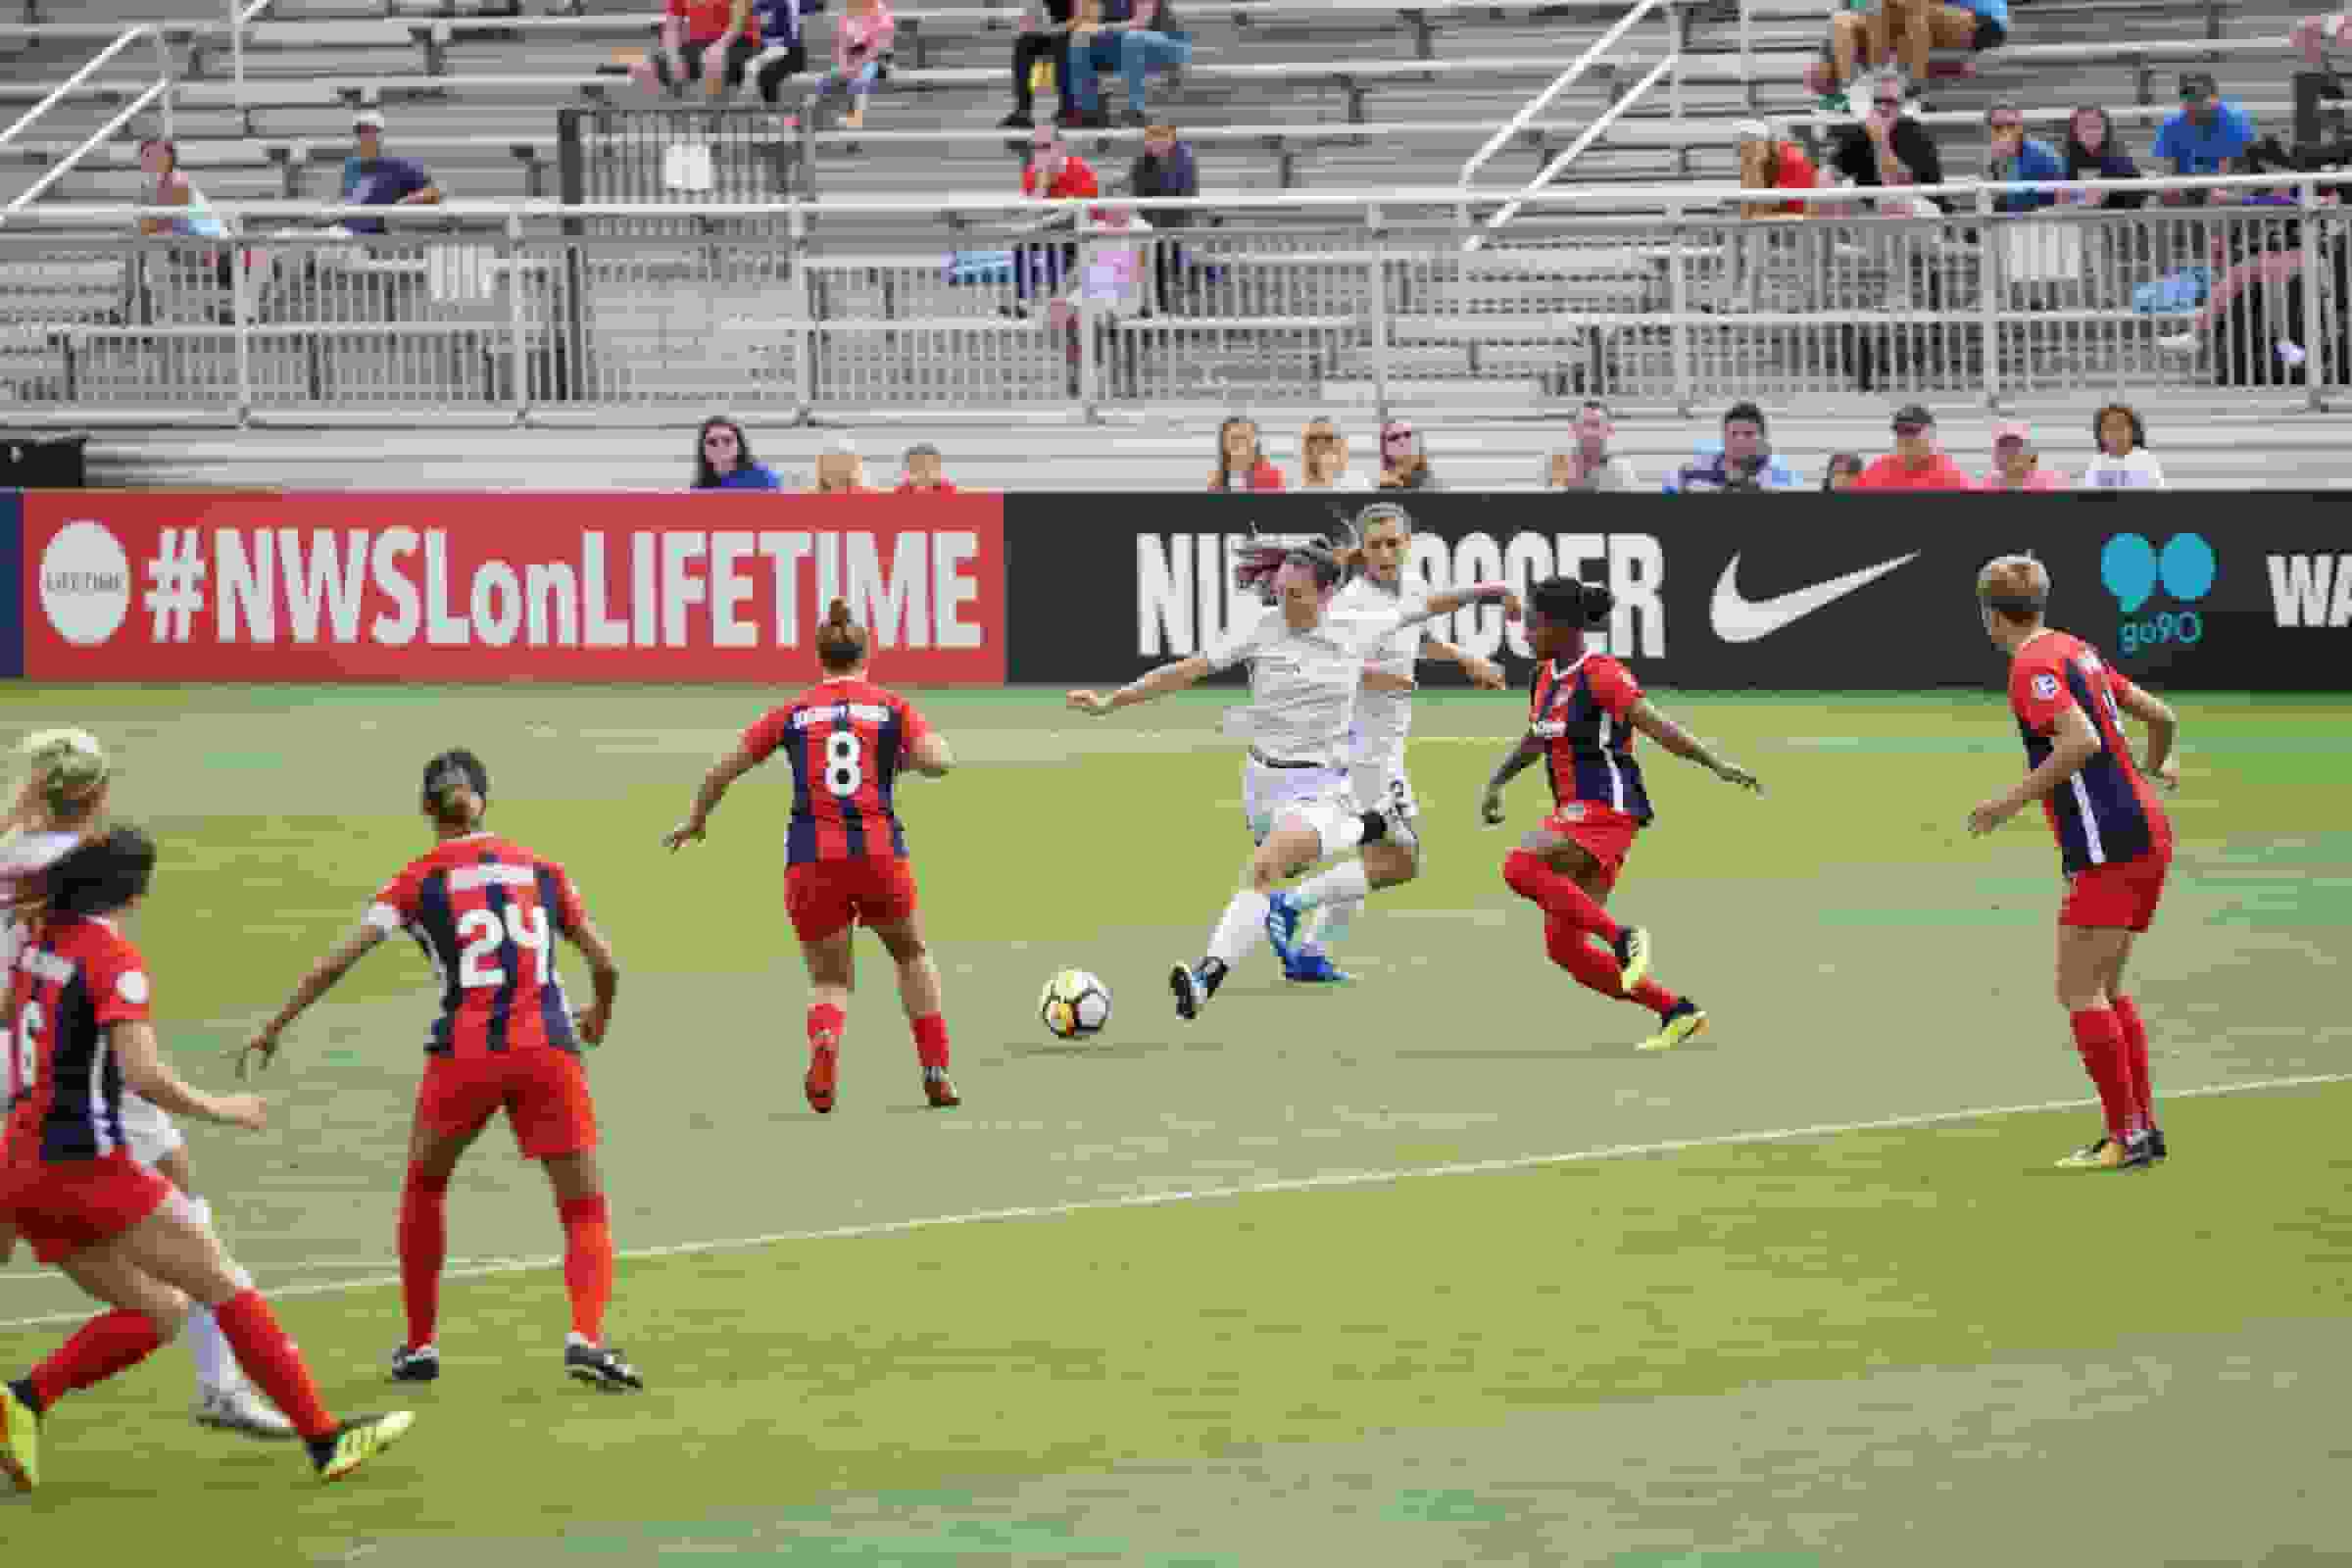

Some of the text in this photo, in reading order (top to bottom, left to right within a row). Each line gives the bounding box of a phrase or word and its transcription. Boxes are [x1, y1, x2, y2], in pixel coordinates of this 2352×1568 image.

[143, 524, 982, 648] #NWSLonLIFETIME
[2117, 611, 2203, 655] go90
[824, 731, 862, 798] 8
[458, 904, 550, 987] 24
